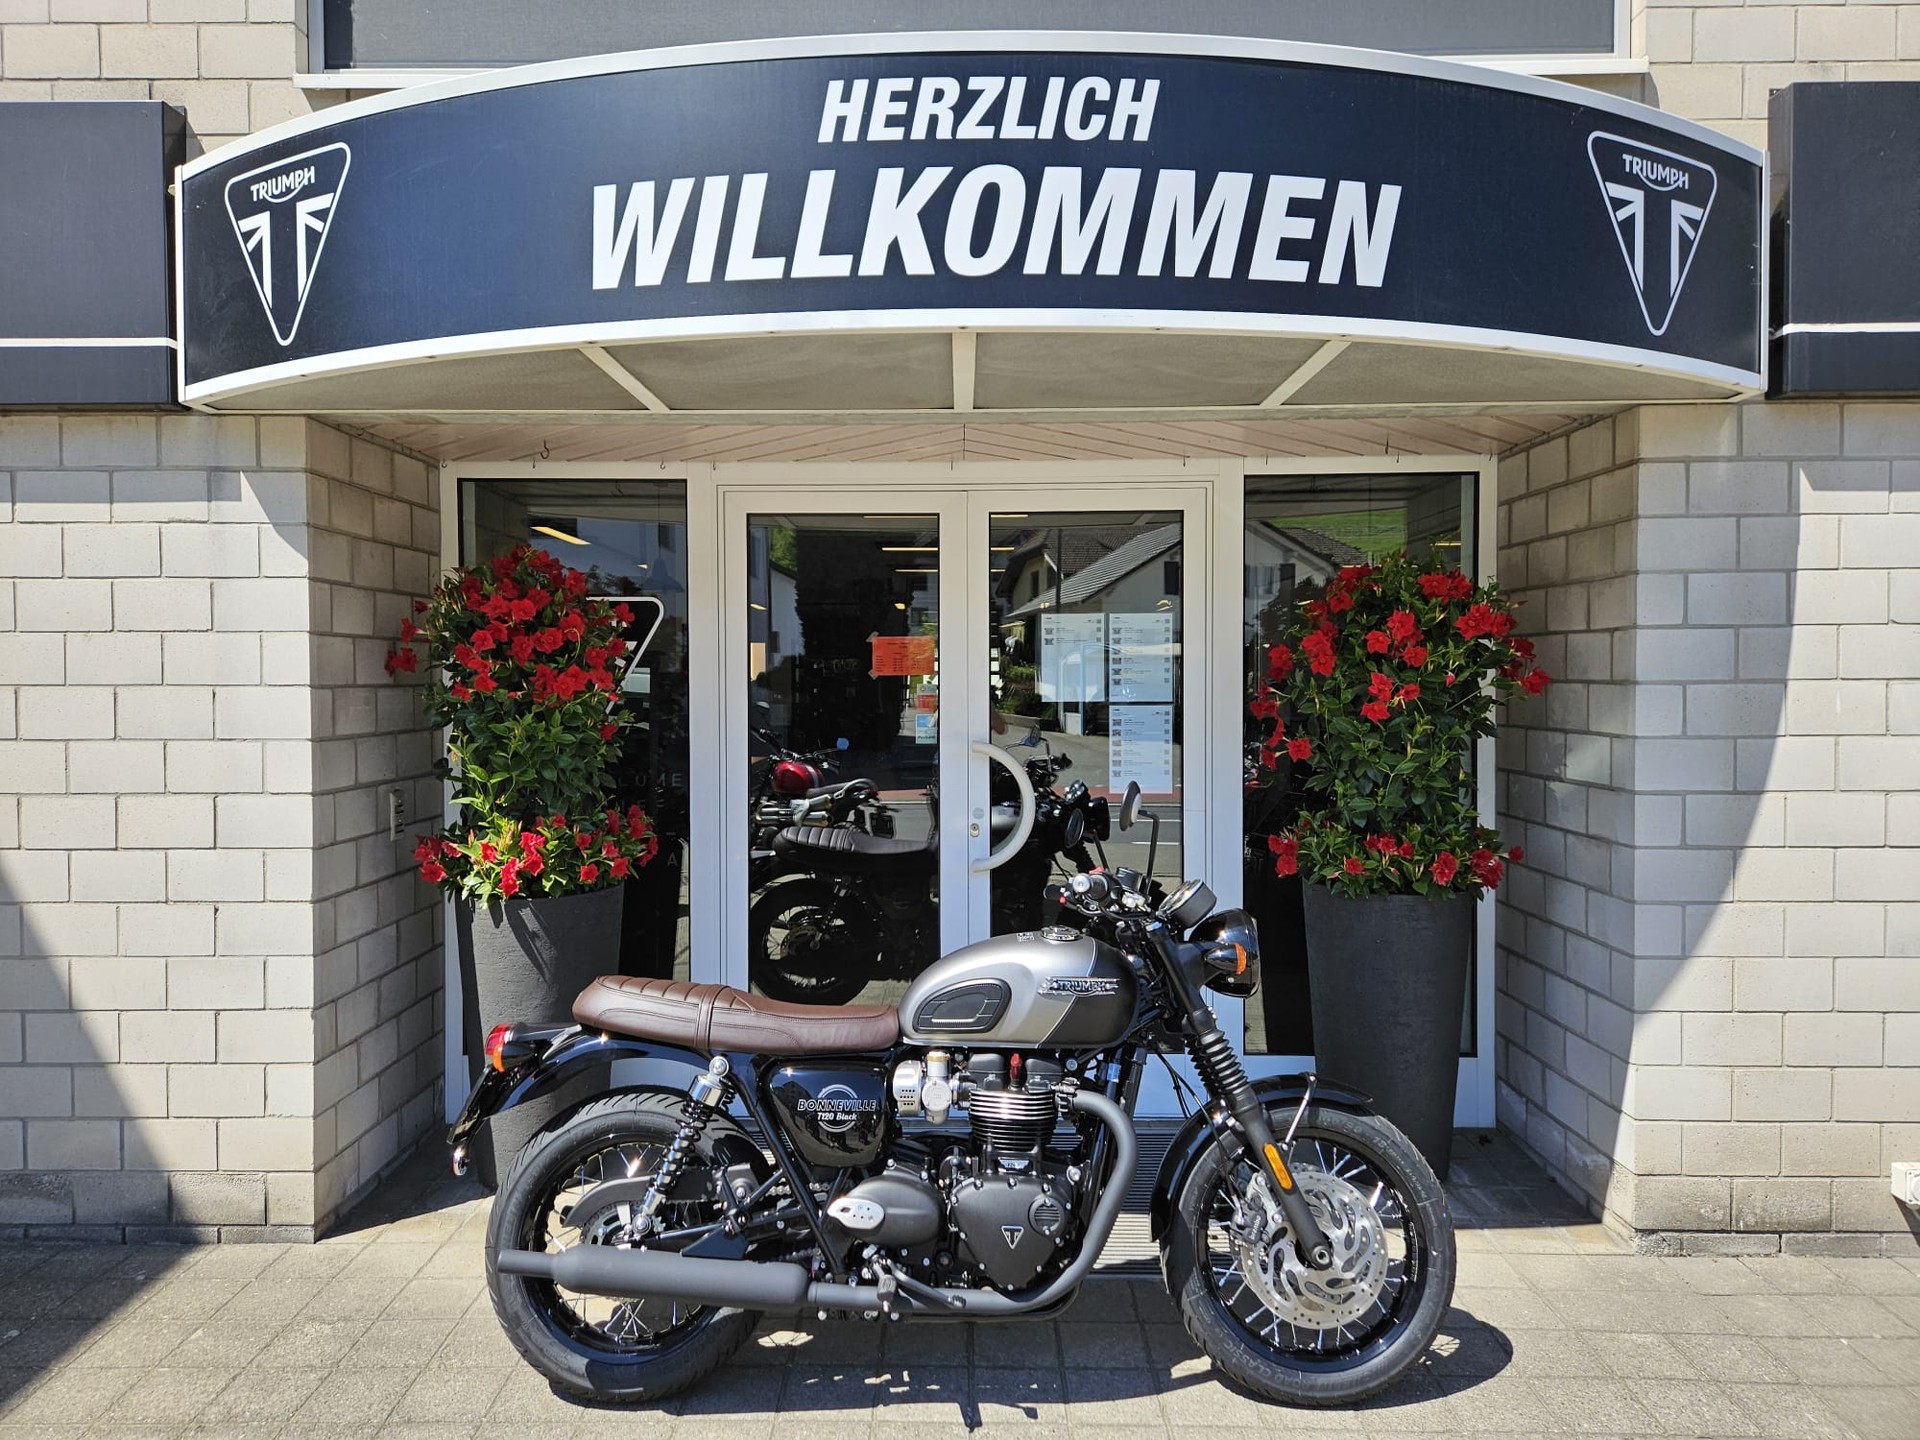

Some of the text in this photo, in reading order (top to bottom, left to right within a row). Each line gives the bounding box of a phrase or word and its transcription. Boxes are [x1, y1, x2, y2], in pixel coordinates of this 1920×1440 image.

[818, 77, 1160, 143] HERZLICH
[250, 166, 315, 203] TRIUMPH
[1622, 153, 1689, 191] TRIUMPH
[592, 164, 1402, 290] WILLKOMMEN
[1057, 979, 1107, 996] TRIUMPH
[797, 1098, 877, 1112] BONNEVILLE
[816, 1112, 857, 1121] T120 Black
